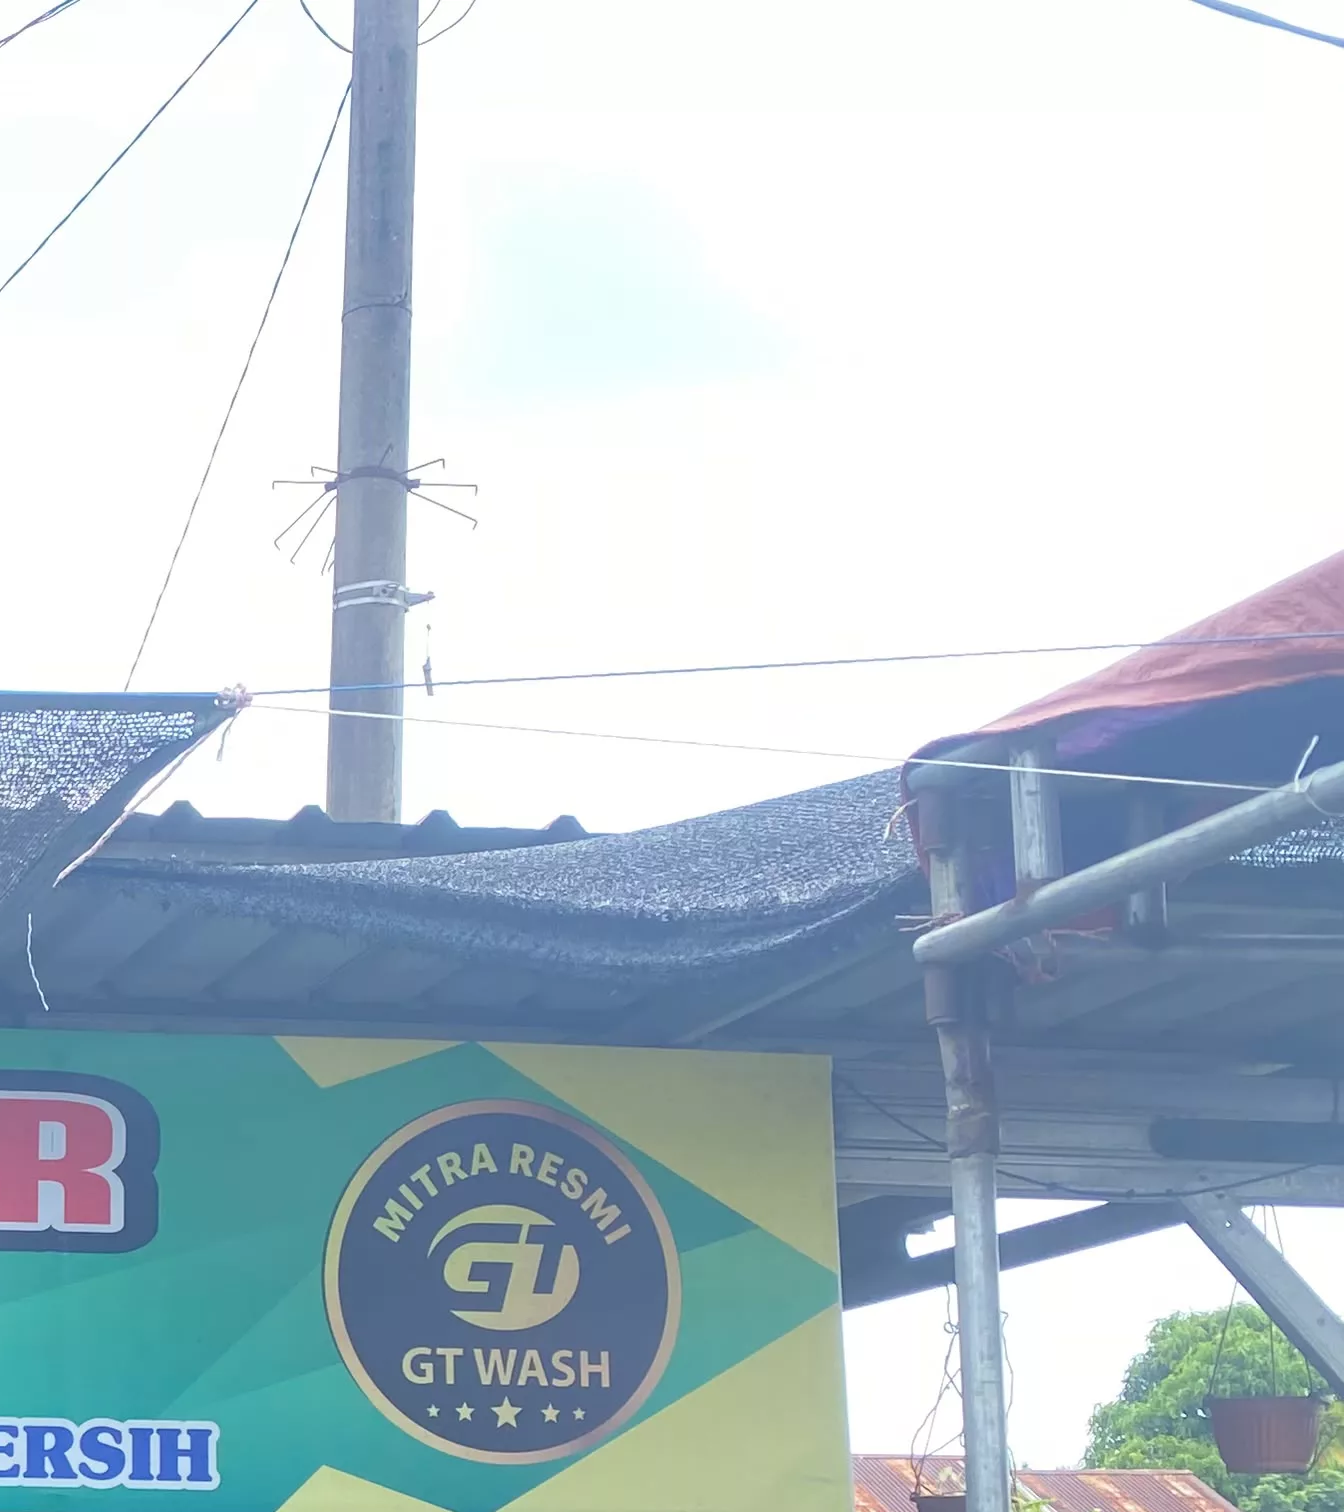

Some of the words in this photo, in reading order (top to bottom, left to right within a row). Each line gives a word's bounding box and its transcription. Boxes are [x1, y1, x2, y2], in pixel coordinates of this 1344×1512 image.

[372, 1142, 499, 1243] MITRA
[508, 1142, 632, 1245] RESMI
[401, 1346, 464, 1387] GT
[472, 1347, 612, 1389] WASH
